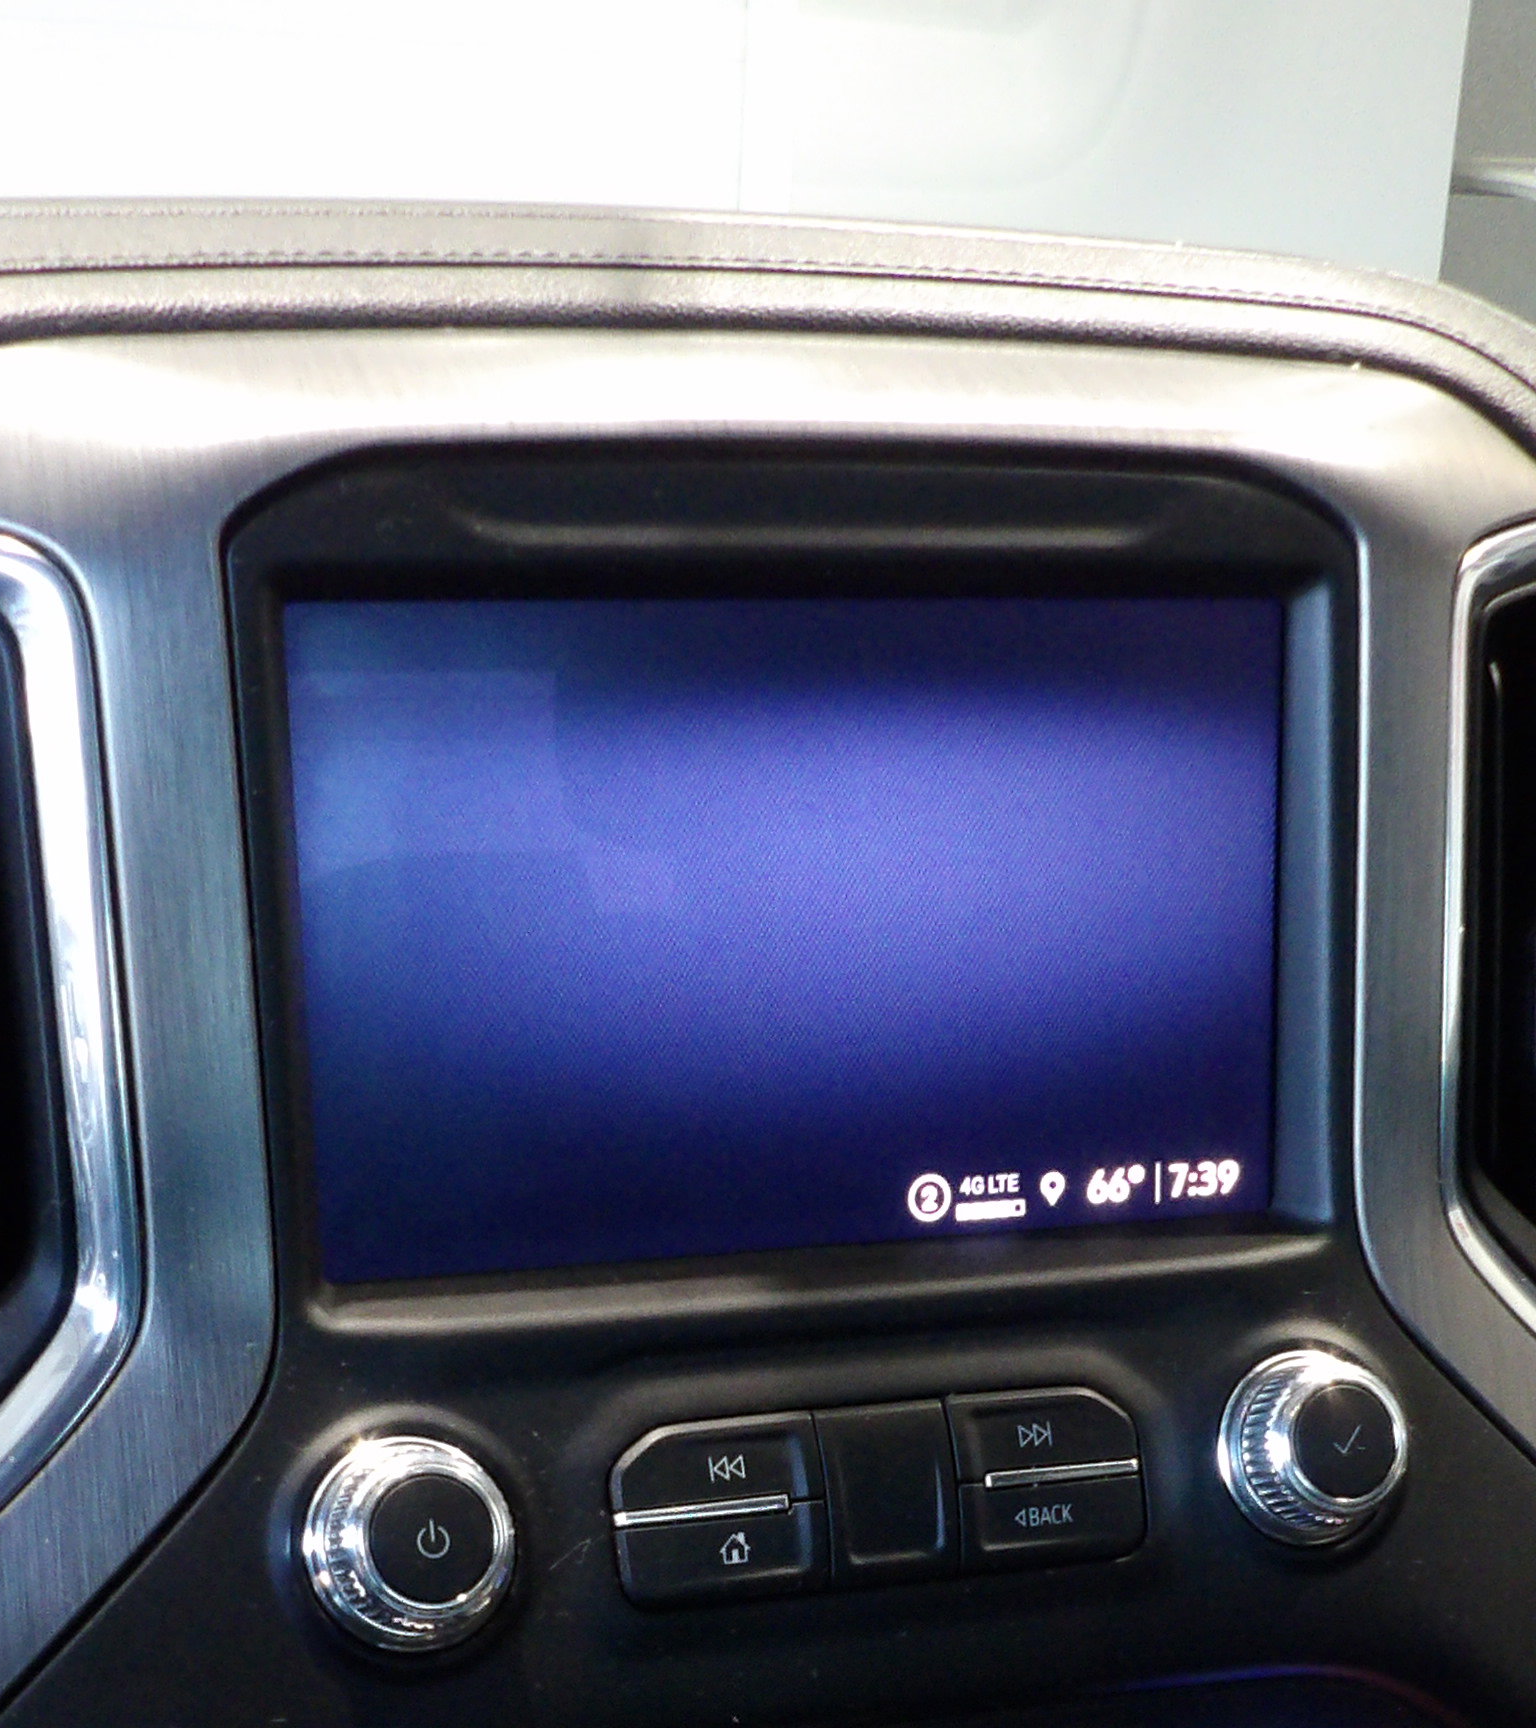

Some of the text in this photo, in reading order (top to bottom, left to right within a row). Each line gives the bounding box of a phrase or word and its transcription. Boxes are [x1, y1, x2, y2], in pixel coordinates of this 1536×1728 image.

[960, 1173, 1021, 1196] 4G LTE
[1168, 1159, 1242, 1199] 7:39
[1028, 1503, 1074, 1527] BACK
